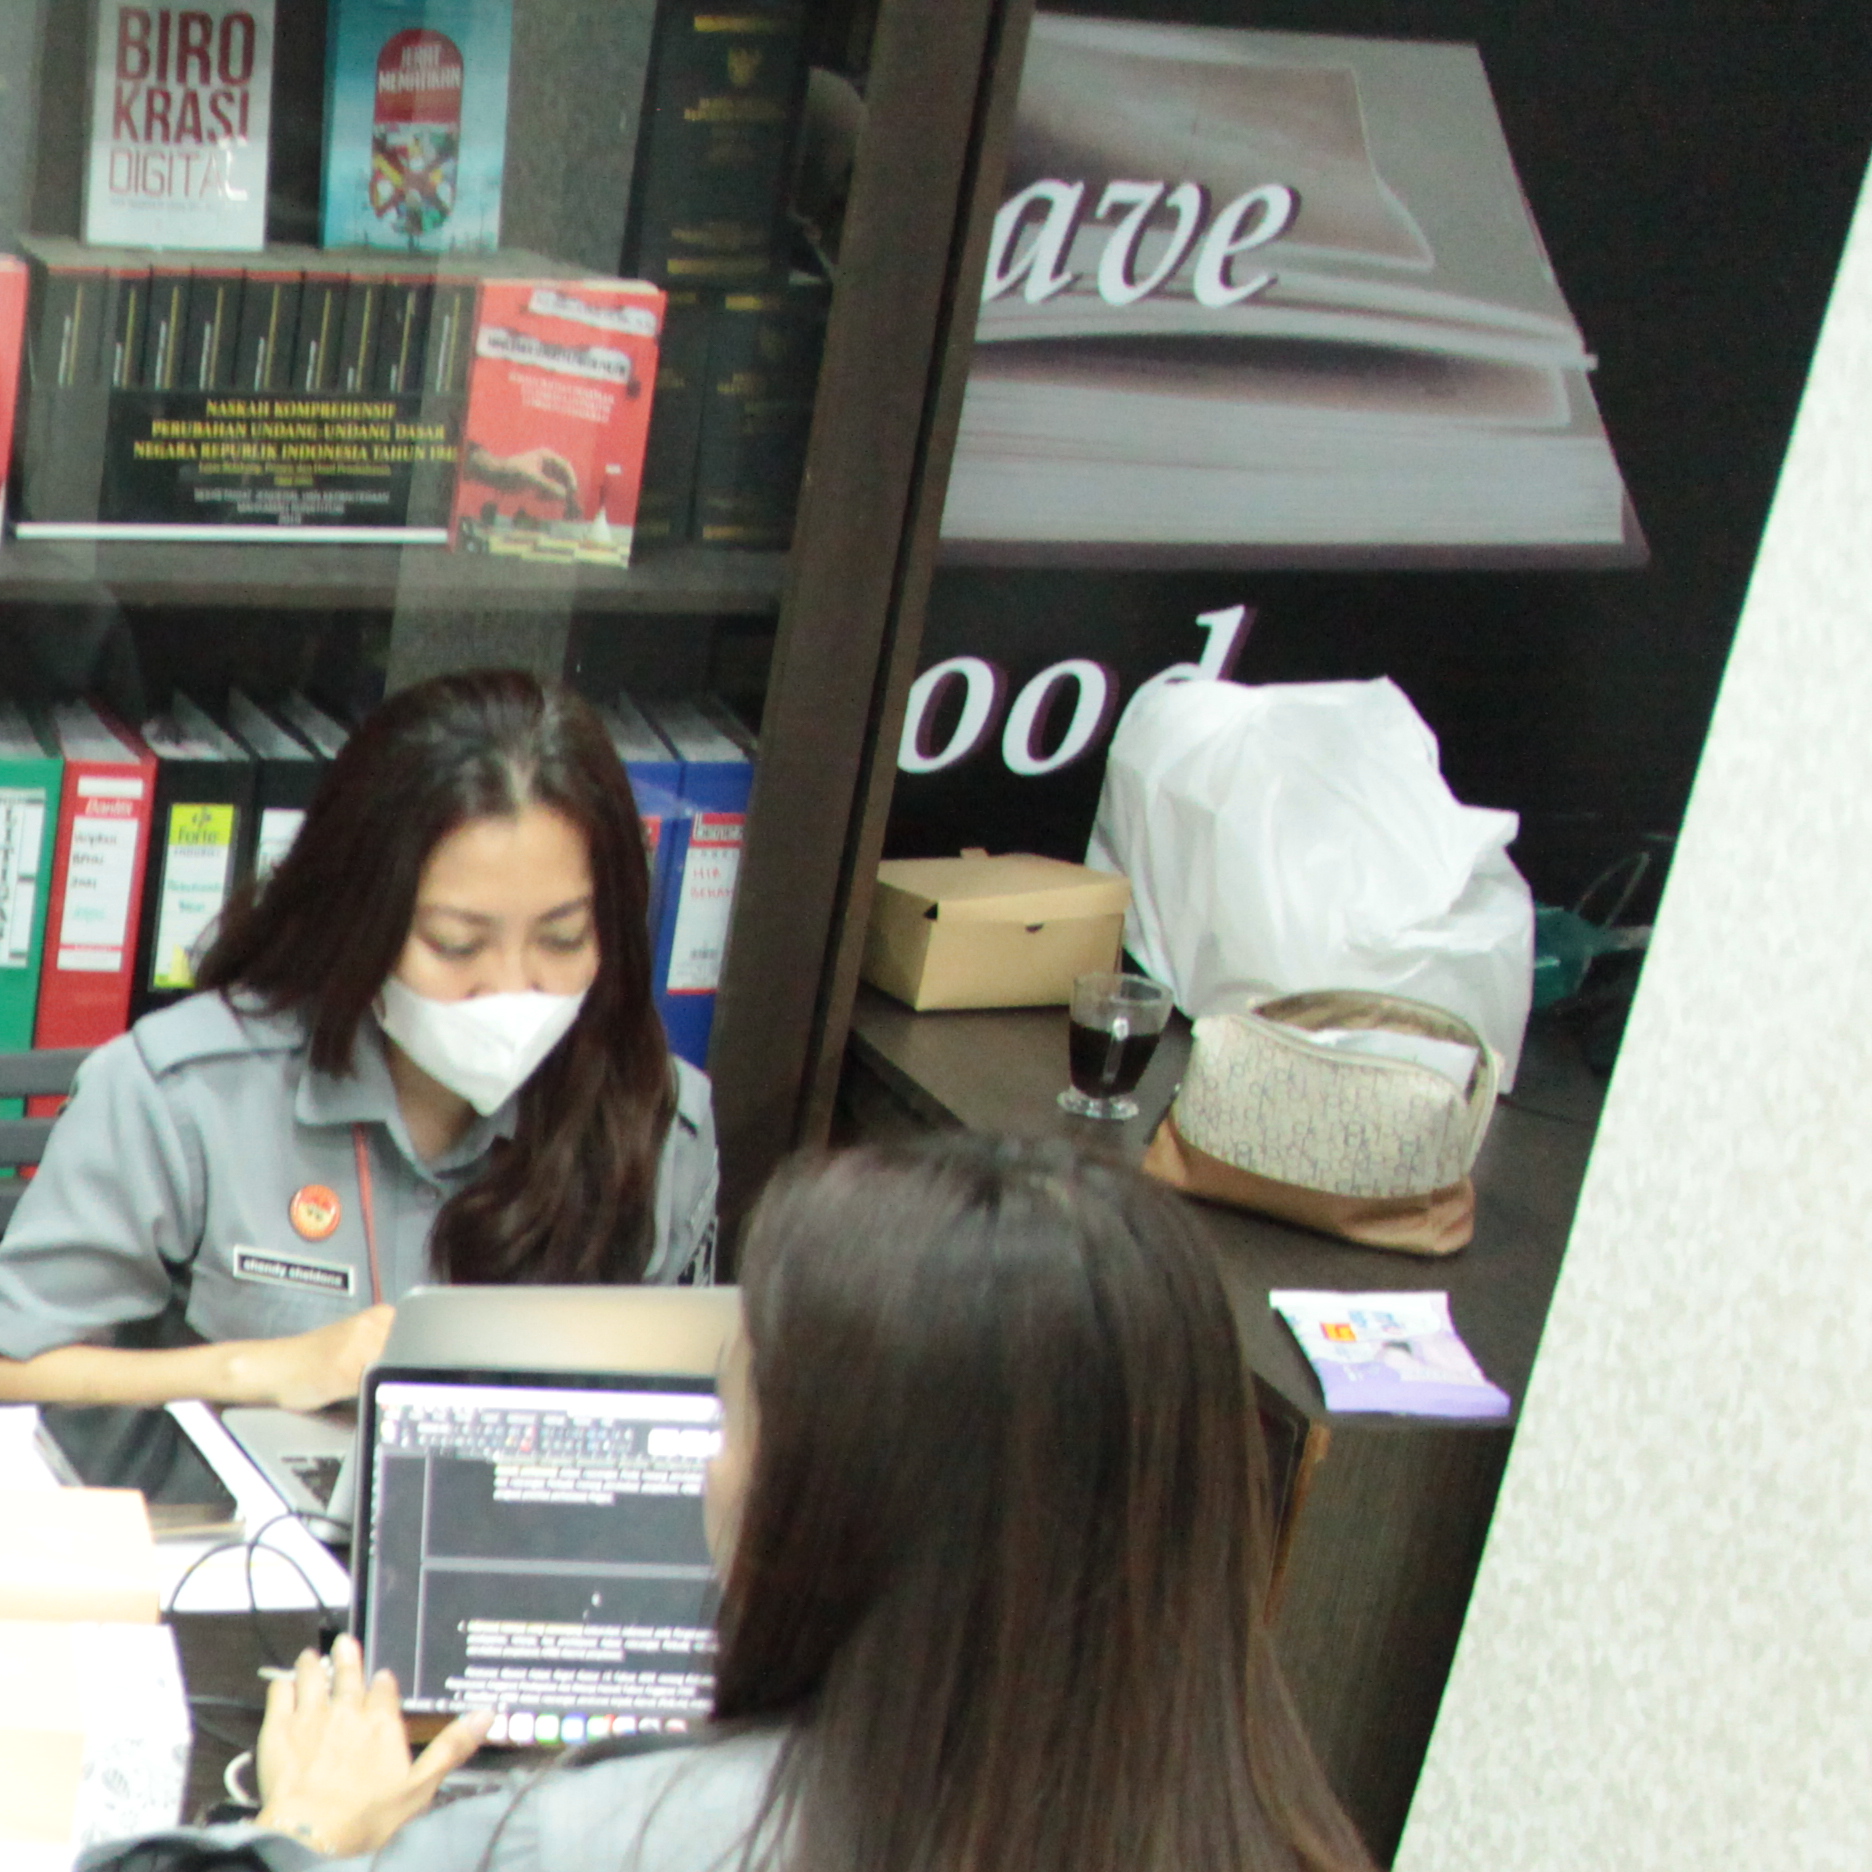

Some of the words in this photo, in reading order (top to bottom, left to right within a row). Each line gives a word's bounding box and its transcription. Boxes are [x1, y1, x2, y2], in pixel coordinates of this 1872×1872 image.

[116, 8, 256, 87] BIRO
[113, 82, 250, 146] KRASI
[109, 146, 248, 201] DIGITAL
[206, 399, 270, 418] NASKAH
[274, 401, 396, 420] KOMPREHENSIF
[152, 419, 248, 439] PERUBAHAN
[395, 424, 446, 441] DASAR
[133, 440, 197, 460] NEGARA
[200, 441, 278, 461] REPUBLIK
[282, 442, 369, 462] INDONESIA
[373, 444, 426, 462] TAHUN
